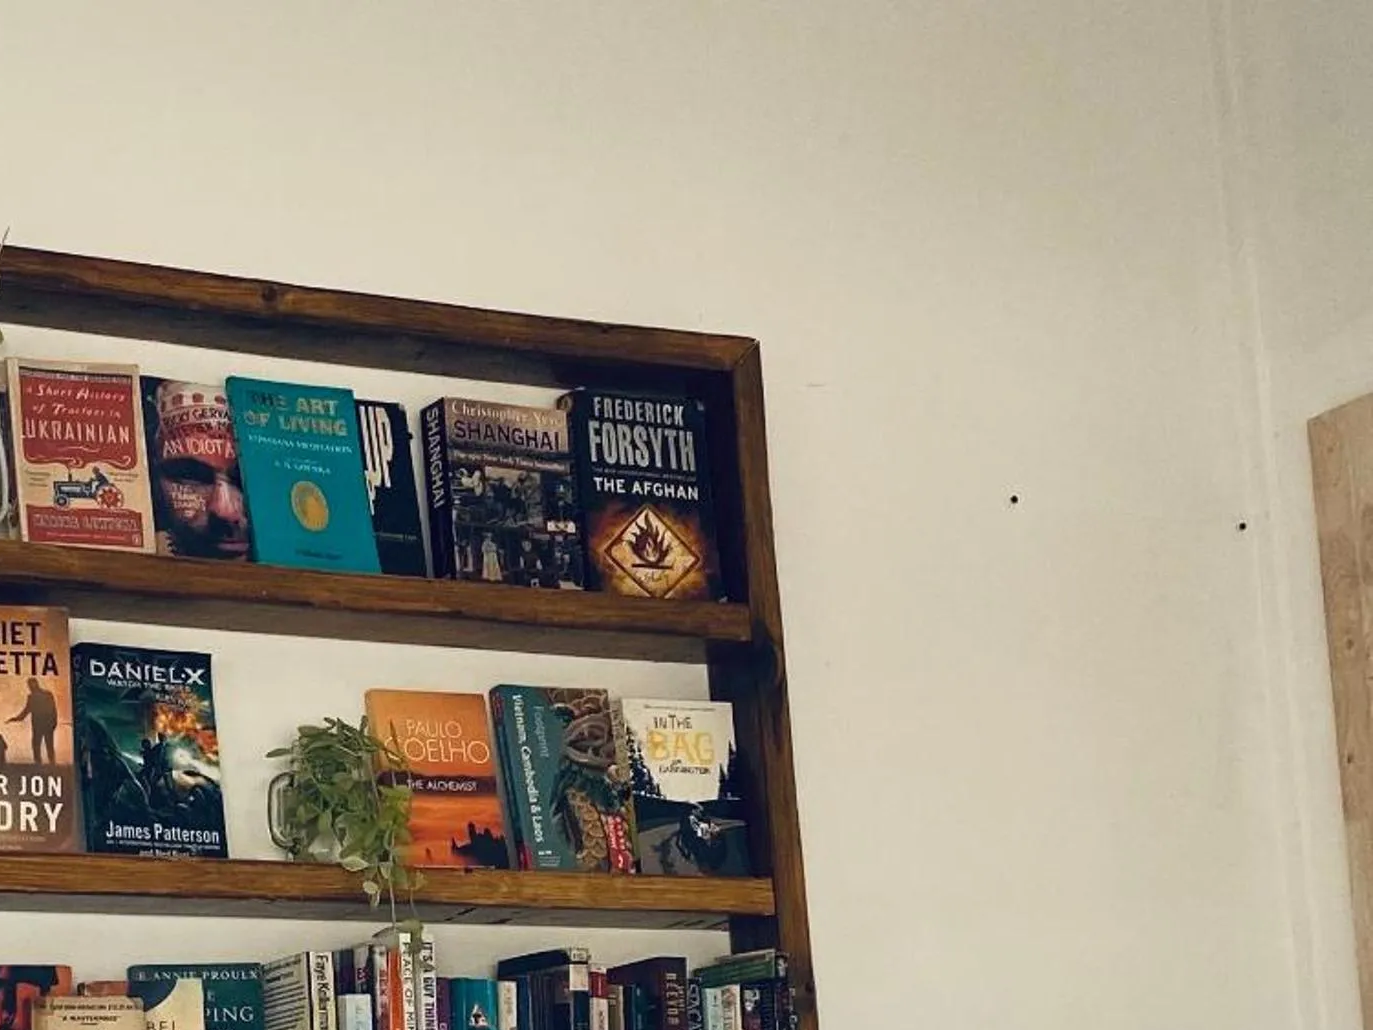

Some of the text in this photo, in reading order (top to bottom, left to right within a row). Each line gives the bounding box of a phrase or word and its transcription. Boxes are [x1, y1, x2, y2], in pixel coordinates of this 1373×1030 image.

[297, 398, 339, 415] ART
[593, 397, 684, 427] FREDERICK
[21, 418, 129, 444] UKRAINIAN
[244, 409, 271, 427] OF
[278, 415, 348, 436] LIVING
[454, 420, 560, 450] SHANGHAI
[163, 438, 223, 458] AN IDIOT
[427, 407, 446, 509] SHANGHAI
[588, 420, 696, 472] FORSYTH
[593, 477, 699, 501] THE AFGHAN
[406, 719, 462, 738] PAULO
[654, 715, 692, 729] IN THE
[384, 737, 489, 764] COELHO
[648, 731, 714, 764] BAG
[512, 695, 544, 843] Vietnam, Cambodia & Laos
[18, 776, 62, 797] JON
[406, 780, 424, 790] THE
[106, 820, 219, 844] James Patterson
[154, 970, 258, 980] ANNIE PROULX
[315, 955, 333, 981] Faye
[402, 942, 413, 984] PEACE
[403, 988, 414, 1007] OF
[423, 976, 433, 998] GUY
